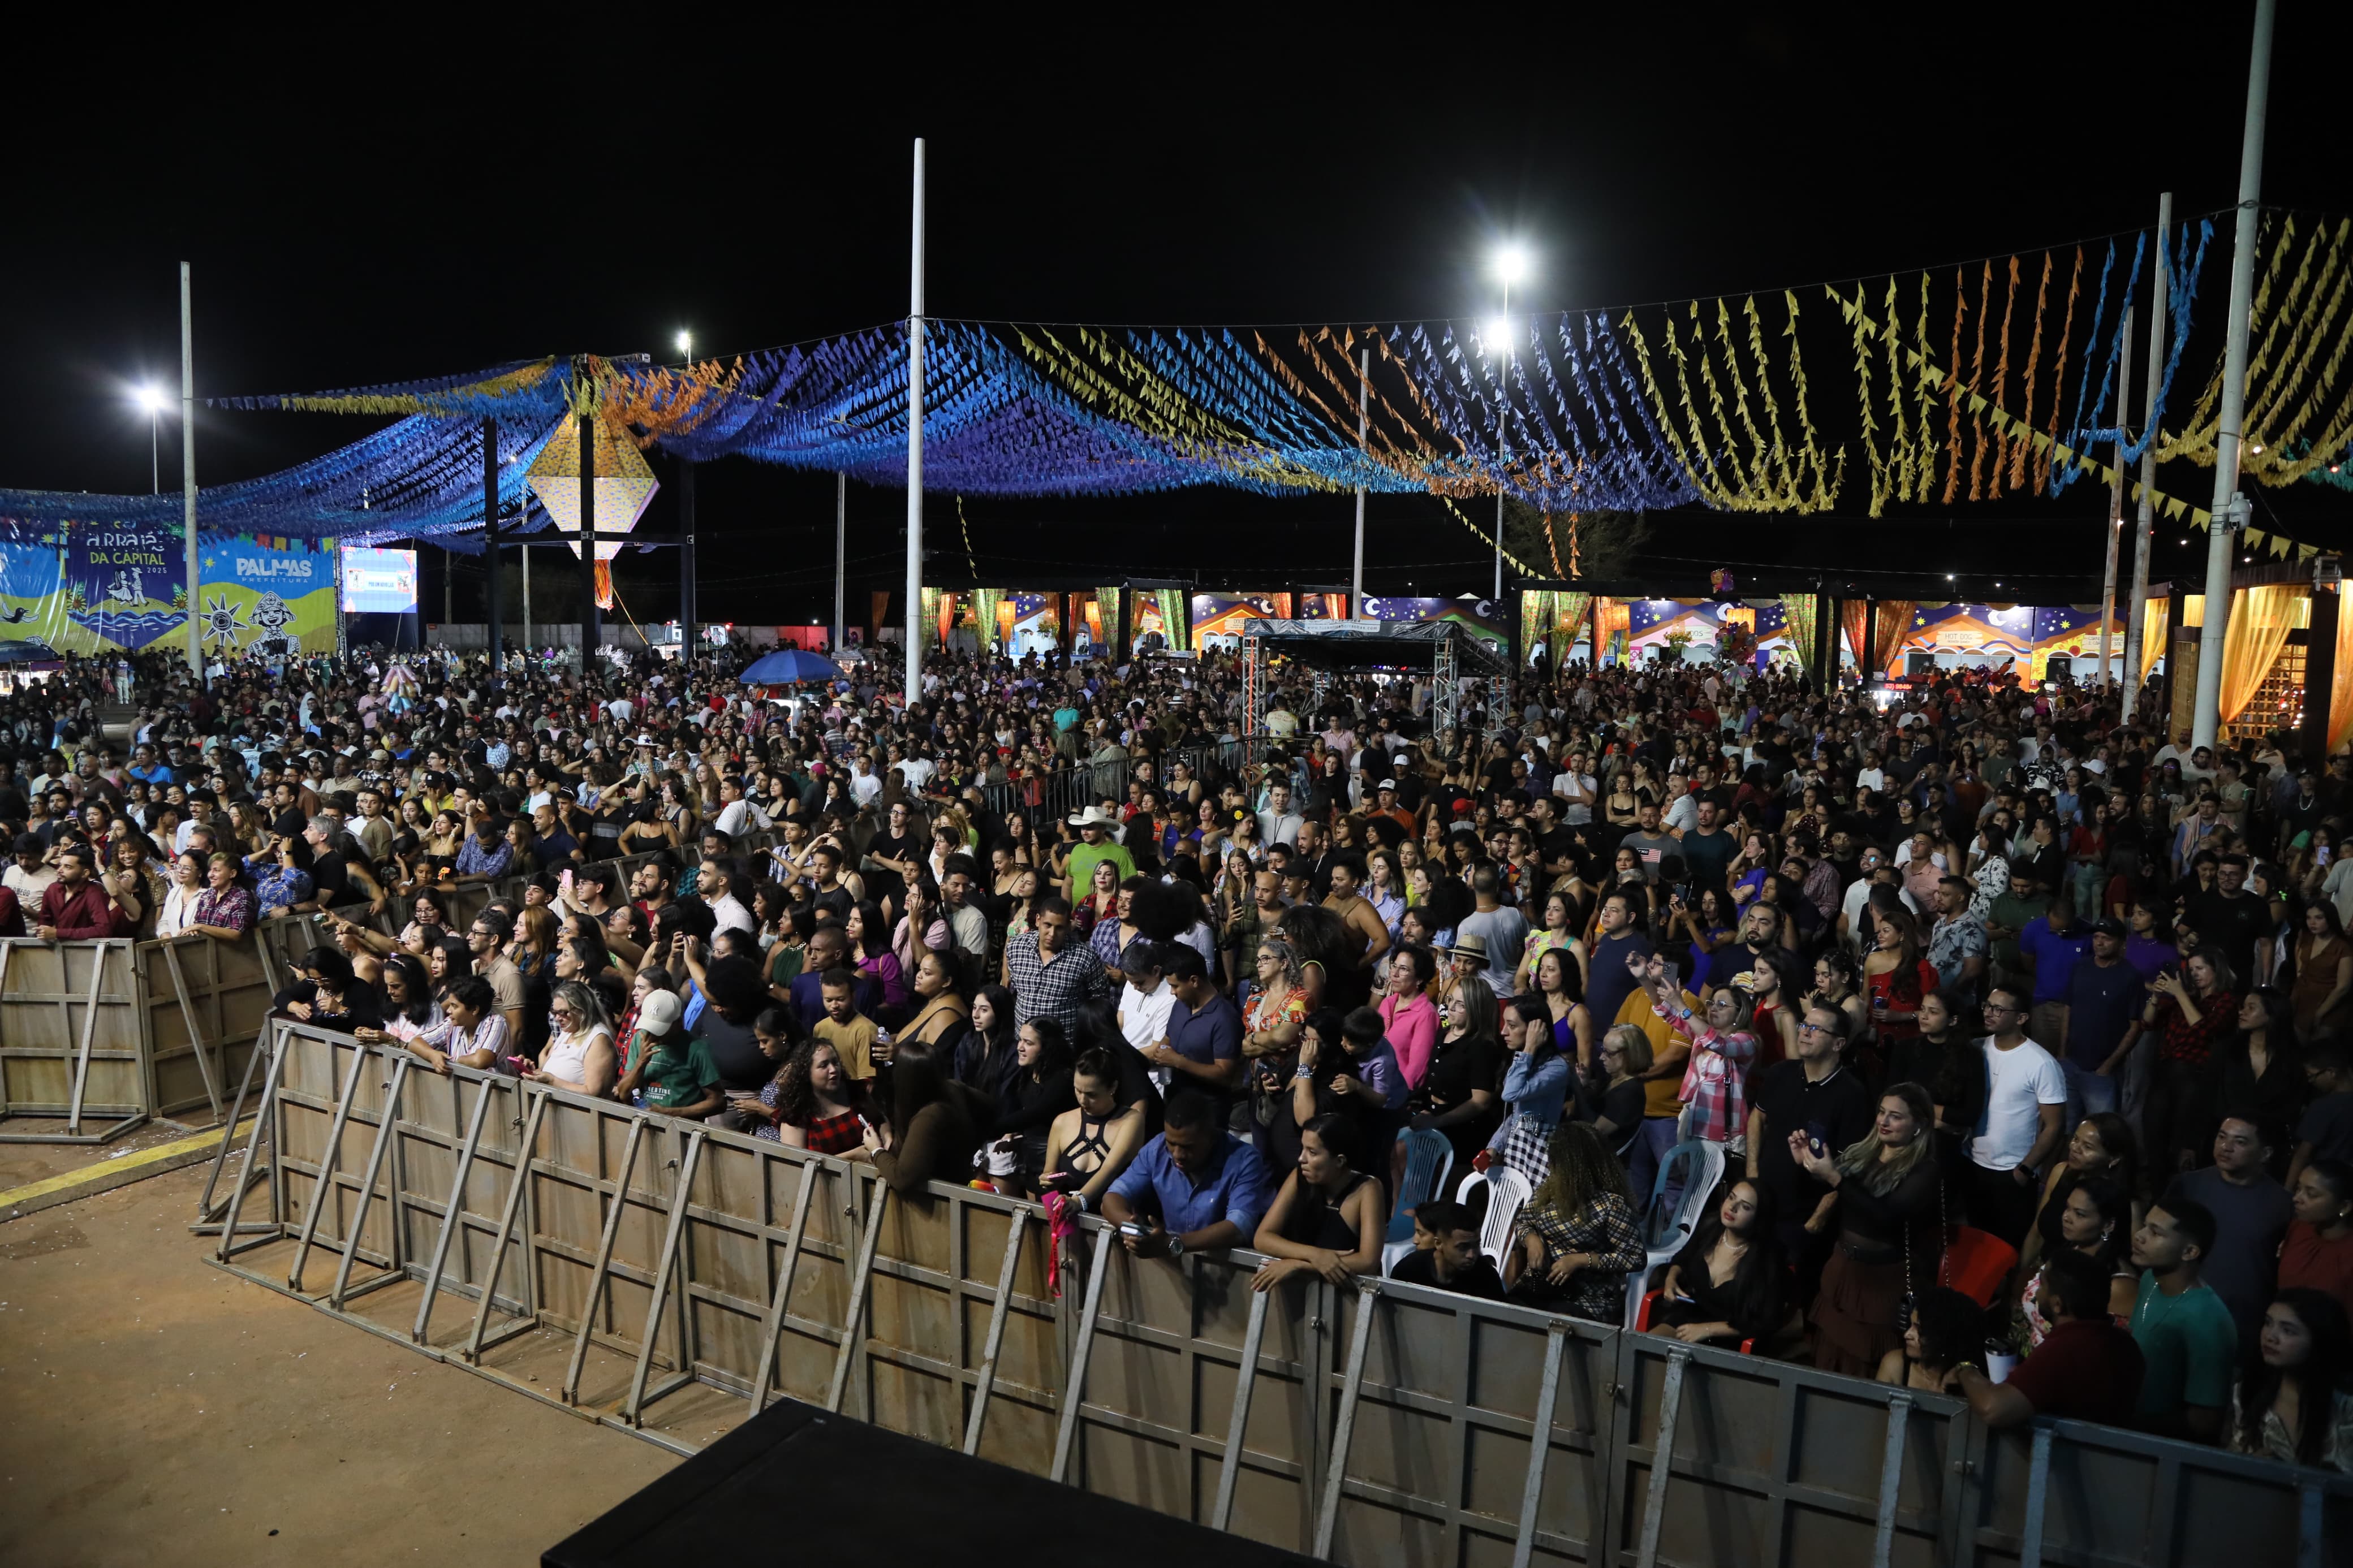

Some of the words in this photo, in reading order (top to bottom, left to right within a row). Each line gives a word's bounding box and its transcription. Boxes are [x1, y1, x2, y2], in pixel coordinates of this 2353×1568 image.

[90, 552, 110, 564] DA
[113, 552, 165, 565] CAPITAL
[236, 558, 313, 577] PALMAS
